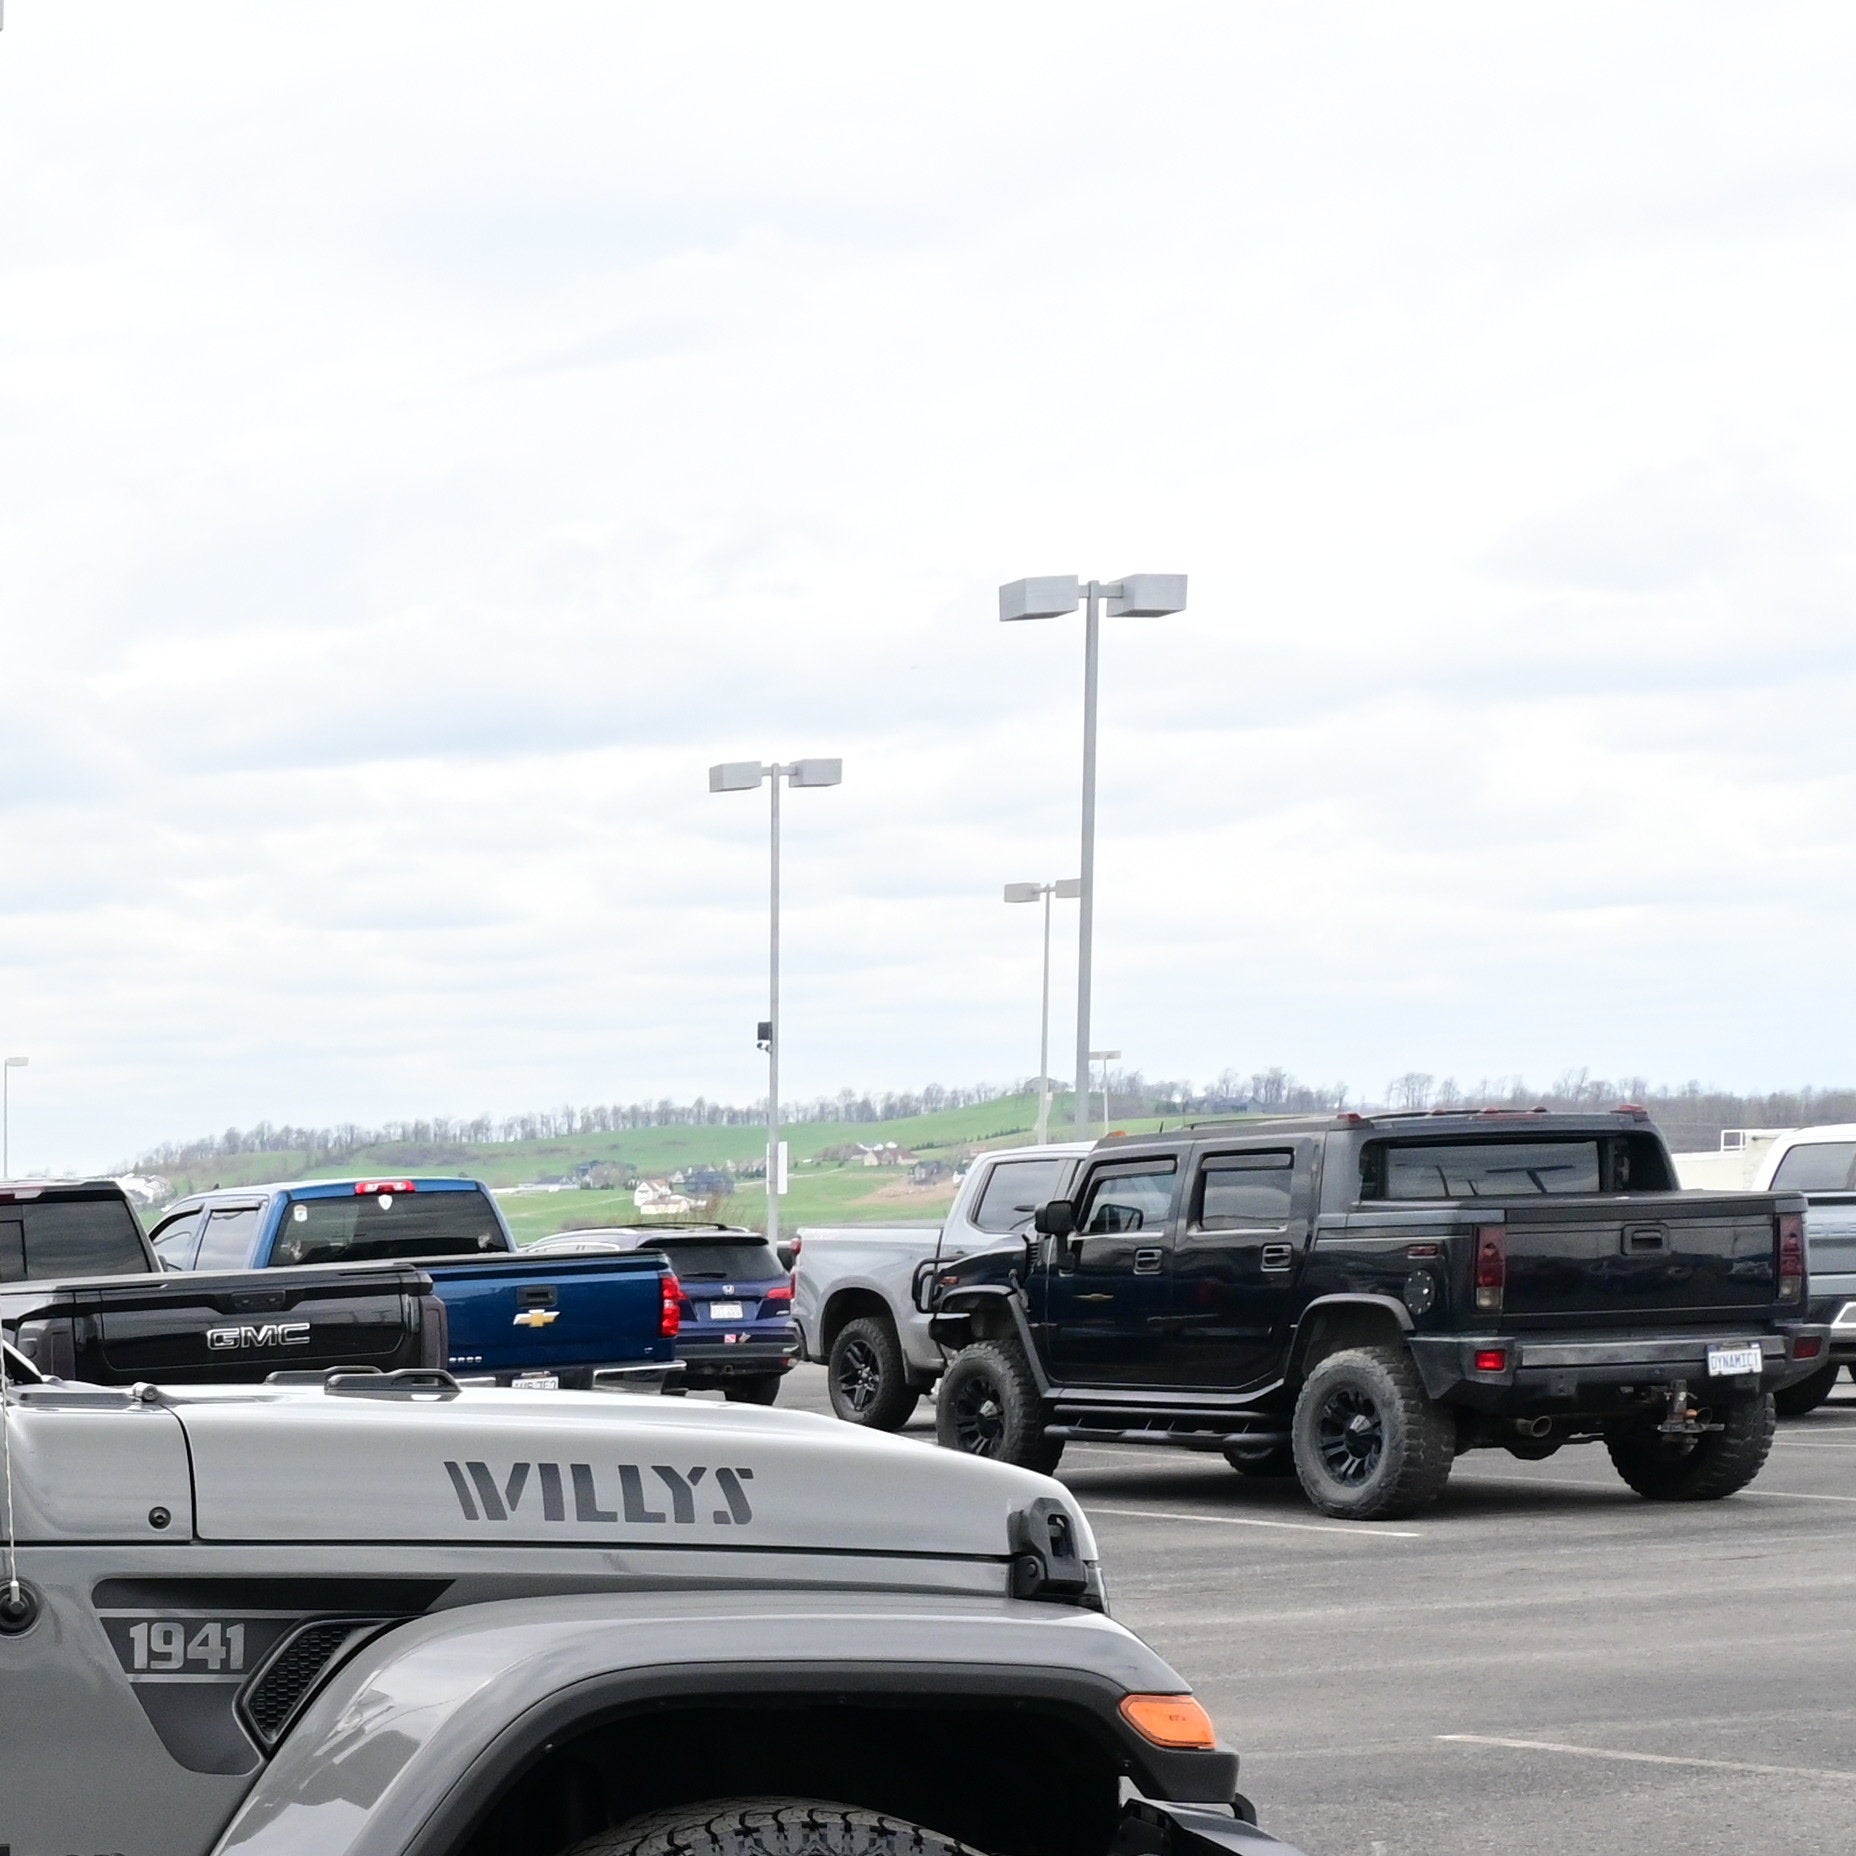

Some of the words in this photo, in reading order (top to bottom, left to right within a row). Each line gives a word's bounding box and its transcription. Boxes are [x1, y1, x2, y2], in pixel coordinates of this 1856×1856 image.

[206, 1322, 310, 1350] GMC
[443, 1461, 755, 1525] WILLYS
[129, 1622, 245, 1670] 1941
